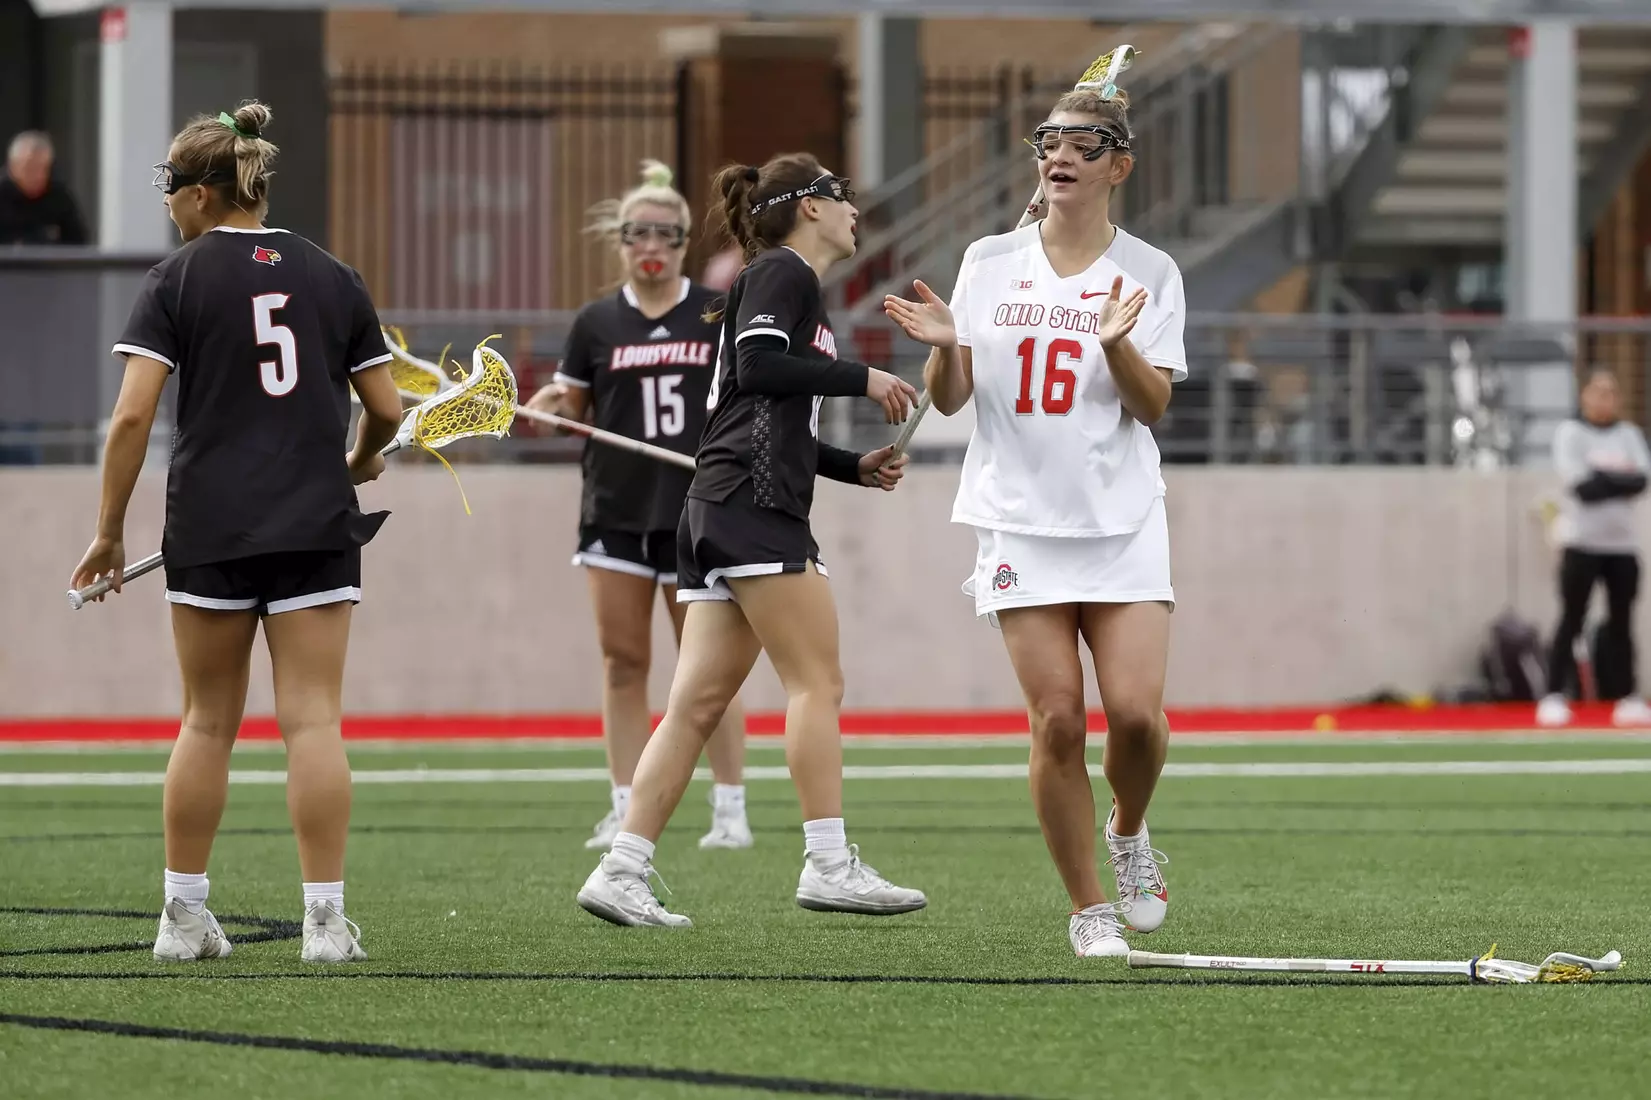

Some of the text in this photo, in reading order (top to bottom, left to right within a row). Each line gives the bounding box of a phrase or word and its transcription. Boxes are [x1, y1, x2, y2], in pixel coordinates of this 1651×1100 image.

[768, 192, 792, 206] GAIT
[749, 314, 776, 324] ACC
[994, 303, 1100, 335] OHIO STA
[251, 292, 299, 397] 5
[609, 340, 713, 371] LOUISVILLE
[1015, 336, 1084, 416] 16
[640, 373, 686, 440] 15
[1209, 960, 1236, 968] EXULT
